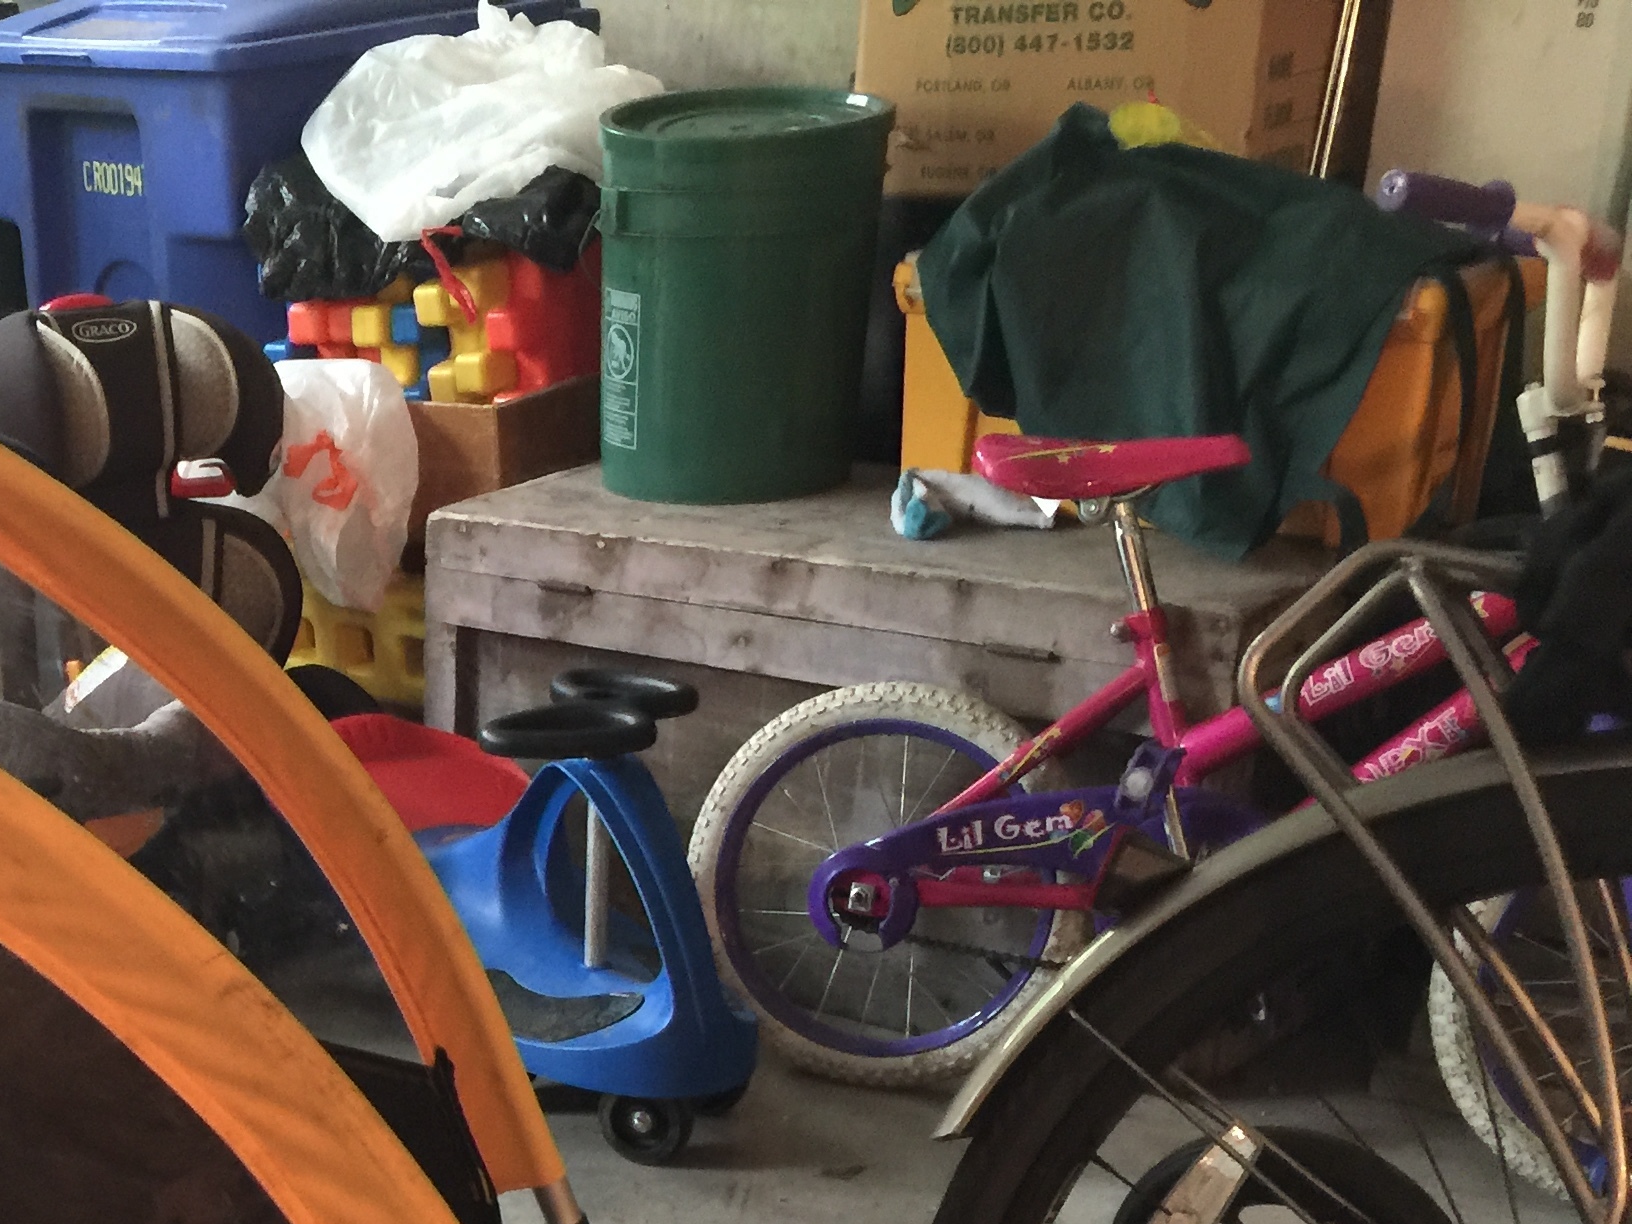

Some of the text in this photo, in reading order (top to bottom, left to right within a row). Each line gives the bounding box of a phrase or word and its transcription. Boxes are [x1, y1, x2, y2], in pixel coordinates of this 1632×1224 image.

[951, 1, 1133, 25] TRANSFER CO.
[945, 30, 1135, 58] (800) 447-1532
[79, 322, 130, 338] GRACO
[1300, 656, 1354, 707] Lil
[936, 814, 1074, 852] Lil Gem
